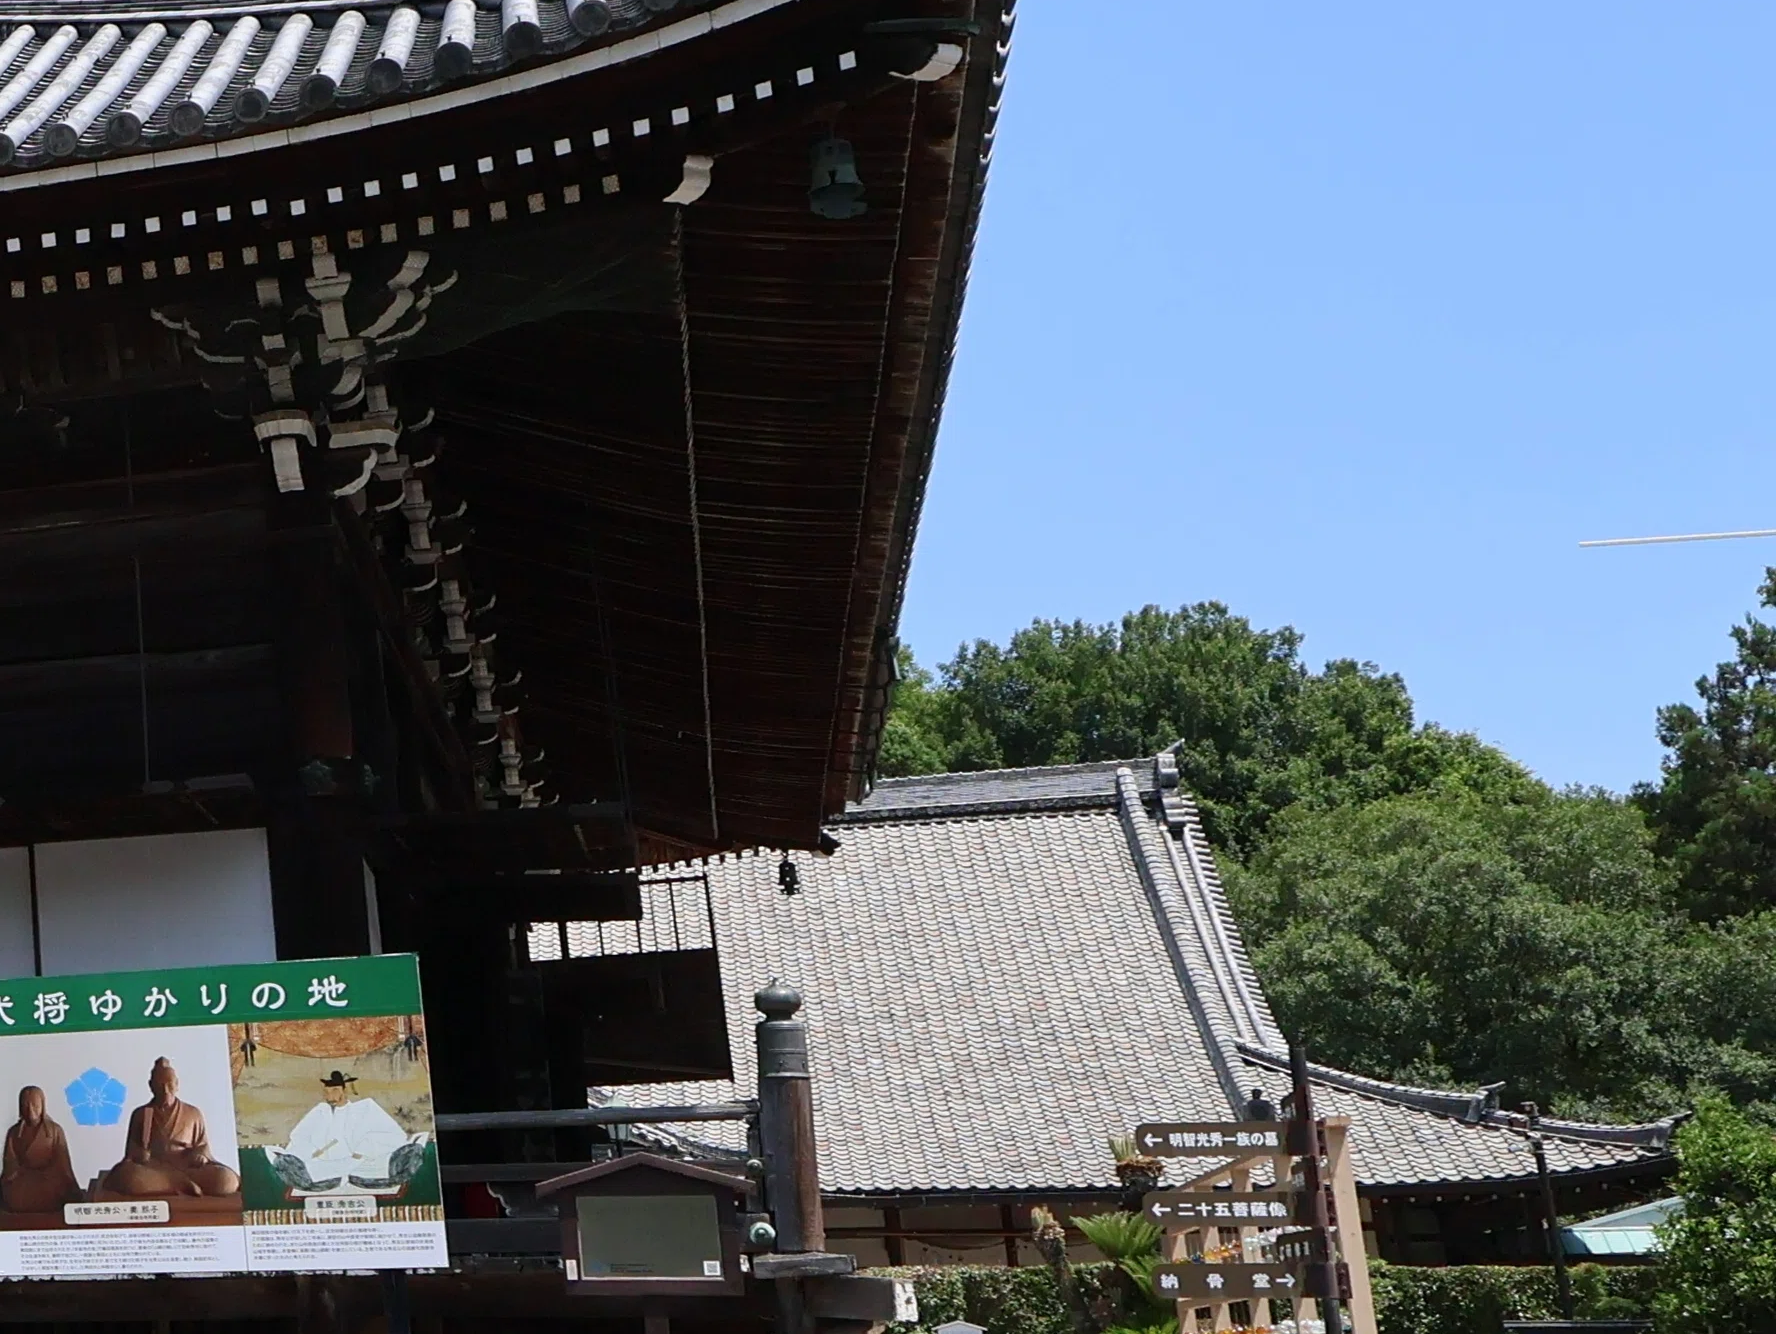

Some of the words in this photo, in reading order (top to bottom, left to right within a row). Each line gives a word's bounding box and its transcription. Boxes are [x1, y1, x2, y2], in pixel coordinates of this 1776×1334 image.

[1168, 1132, 1279, 1148] 明智光秀一族の墓
[1177, 1201, 1288, 1218] 二十五菩薩像
[1159, 1272, 1271, 1289] 納骨堂
